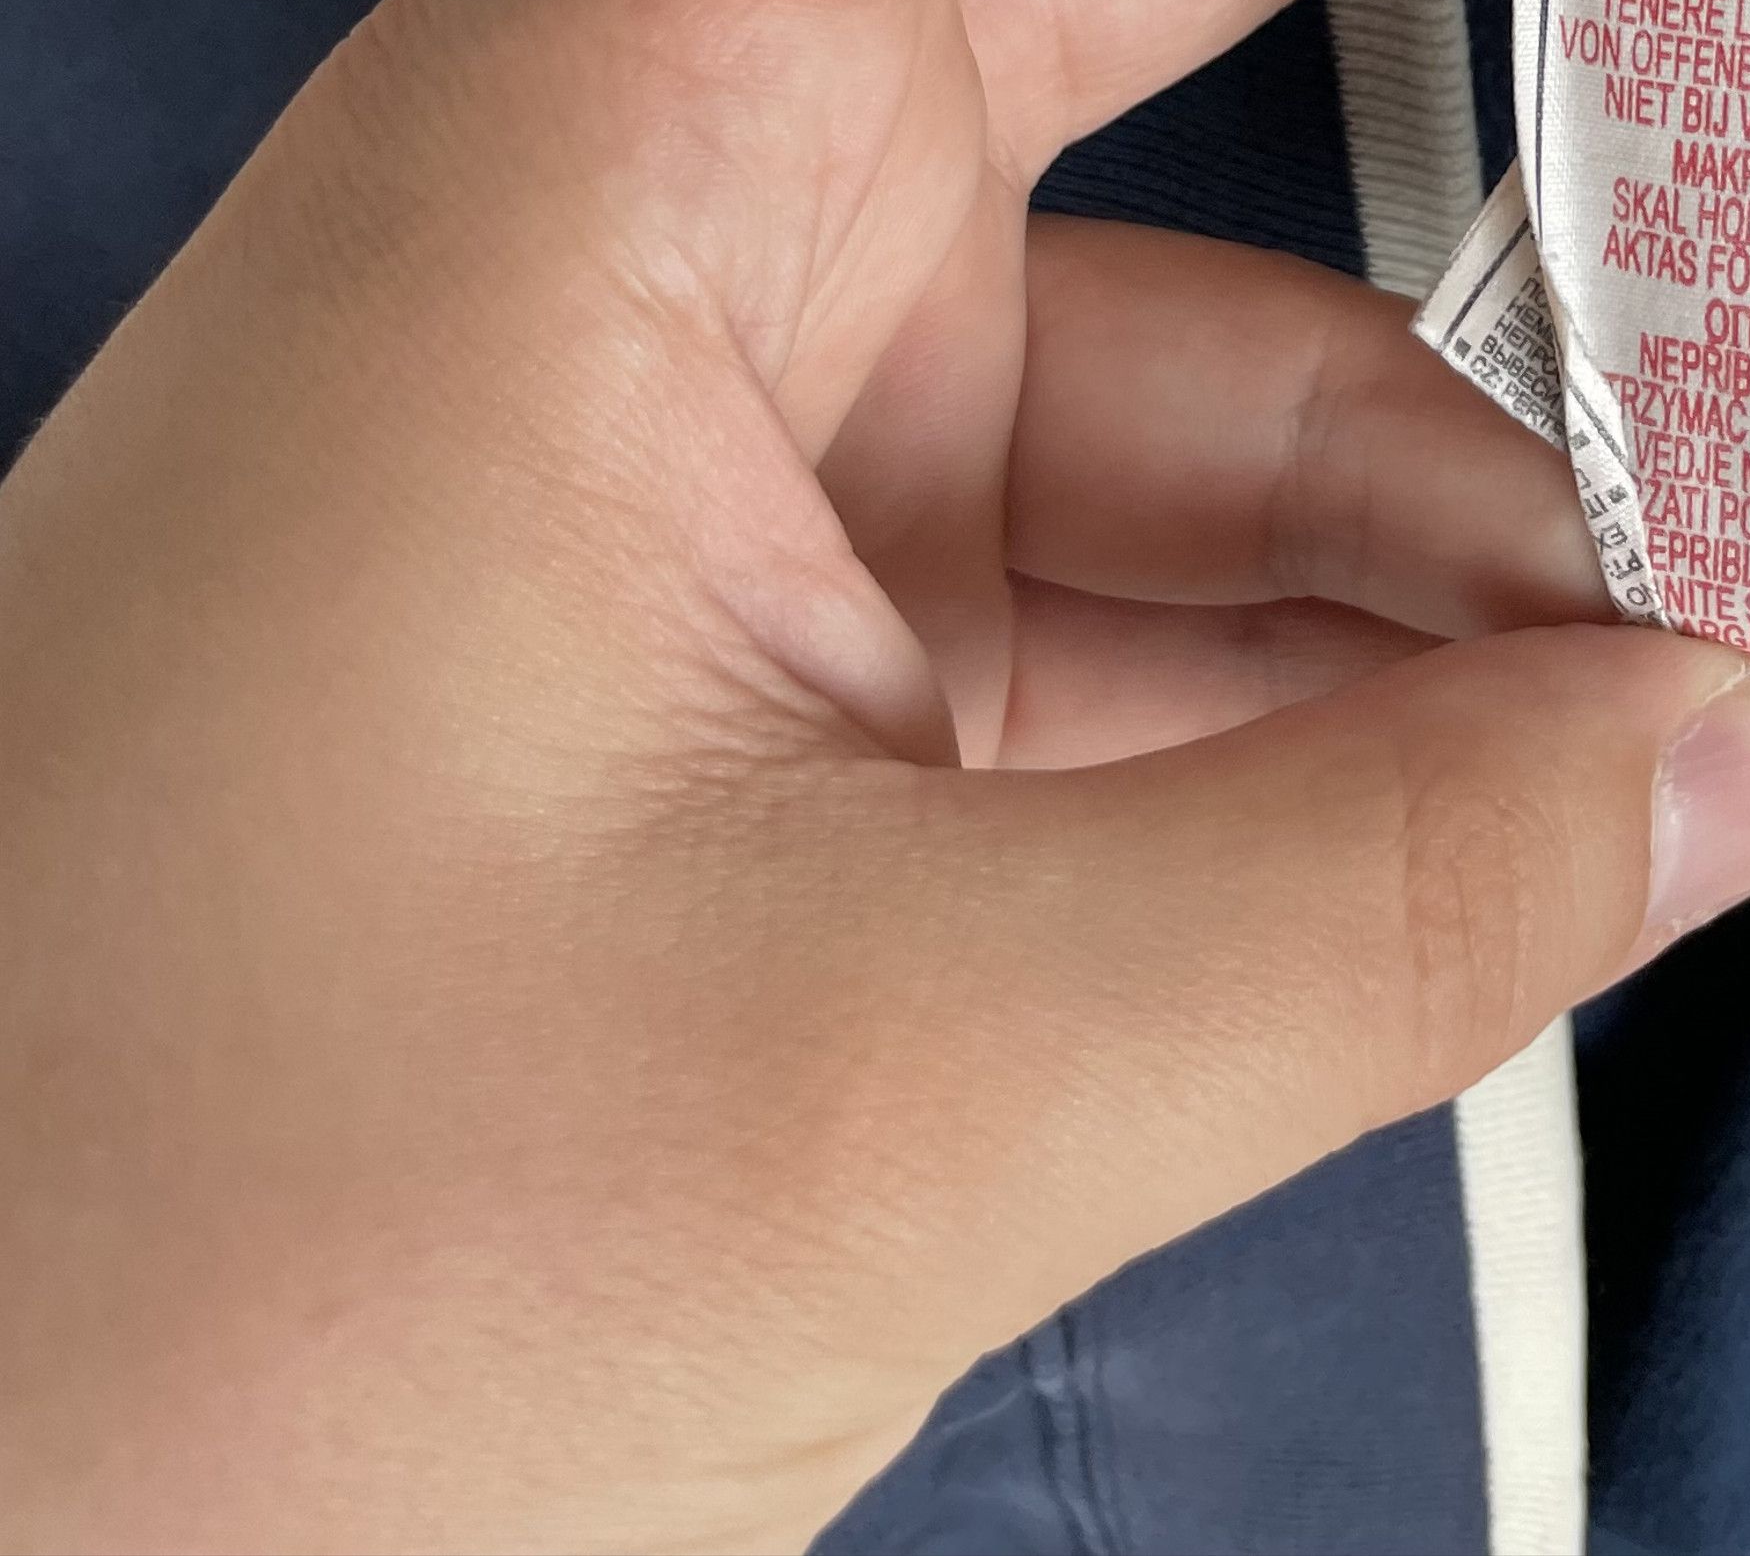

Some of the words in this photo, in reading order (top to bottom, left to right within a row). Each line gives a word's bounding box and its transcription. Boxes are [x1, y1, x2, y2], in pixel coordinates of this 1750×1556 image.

[1558, 14, 1621, 71] VON
[1604, 73, 1675, 128] NIET
[1682, 86, 1729, 138] BIJ
[1612, 176, 1687, 236] SKAL
[1602, 224, 1698, 287] AKTAS
[1656, 574, 1738, 623] NITE
